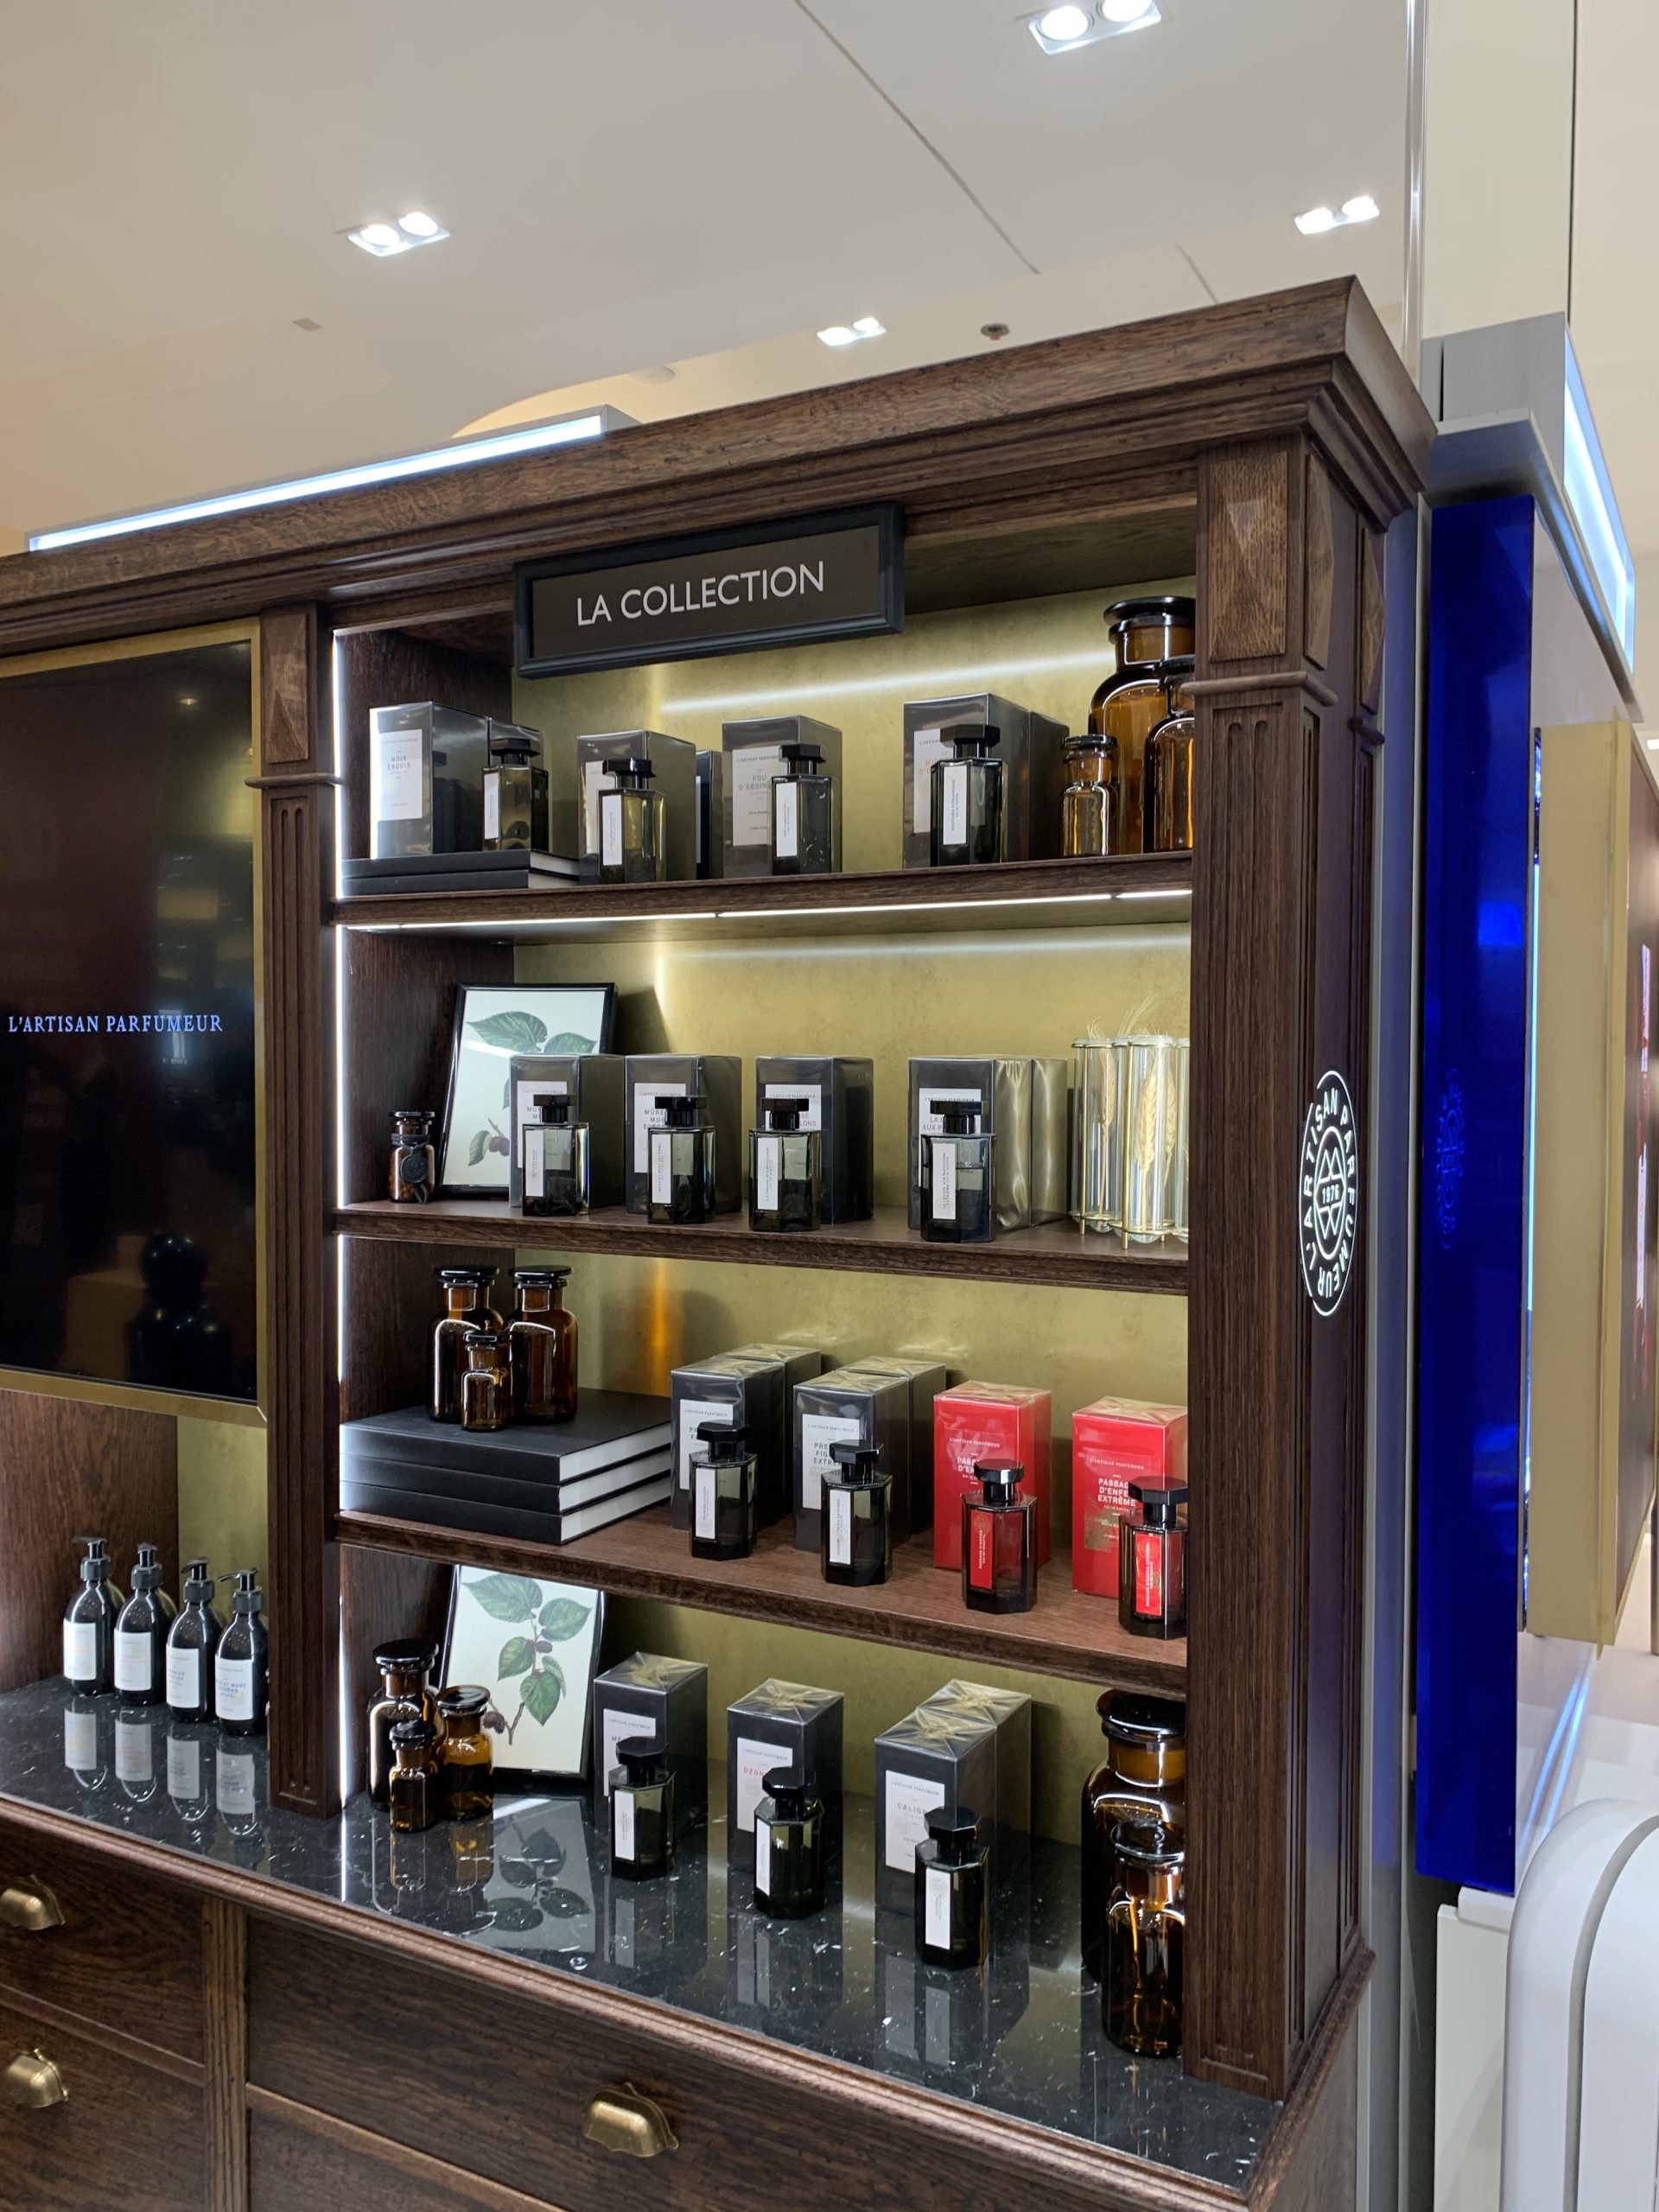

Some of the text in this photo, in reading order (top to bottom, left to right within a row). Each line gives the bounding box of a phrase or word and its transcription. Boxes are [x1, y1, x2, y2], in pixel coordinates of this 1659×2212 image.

[576, 560, 825, 626] LA COLLECTION
[739, 782, 767, 791] D'ABSIN
[9, 1014, 223, 1033] L'ARTISAN PARFUMEUR
[1303, 1087, 1356, 1298] L'ARTISAN PARFUMEUR
[1321, 1183, 1340, 1205] 1976
[814, 1442, 829, 1451] PRE
[957, 1457, 976, 1466] PASS
[957, 1465, 975, 1474] D'EN
[1098, 1478, 1129, 1490] PASSAG
[1099, 1486, 1129, 1497] D'ENFE
[1097, 1494, 1137, 1507] EXTRÊME
[743, 1766, 766, 1777] DZON
[897, 1802, 928, 1815] CALIGN
